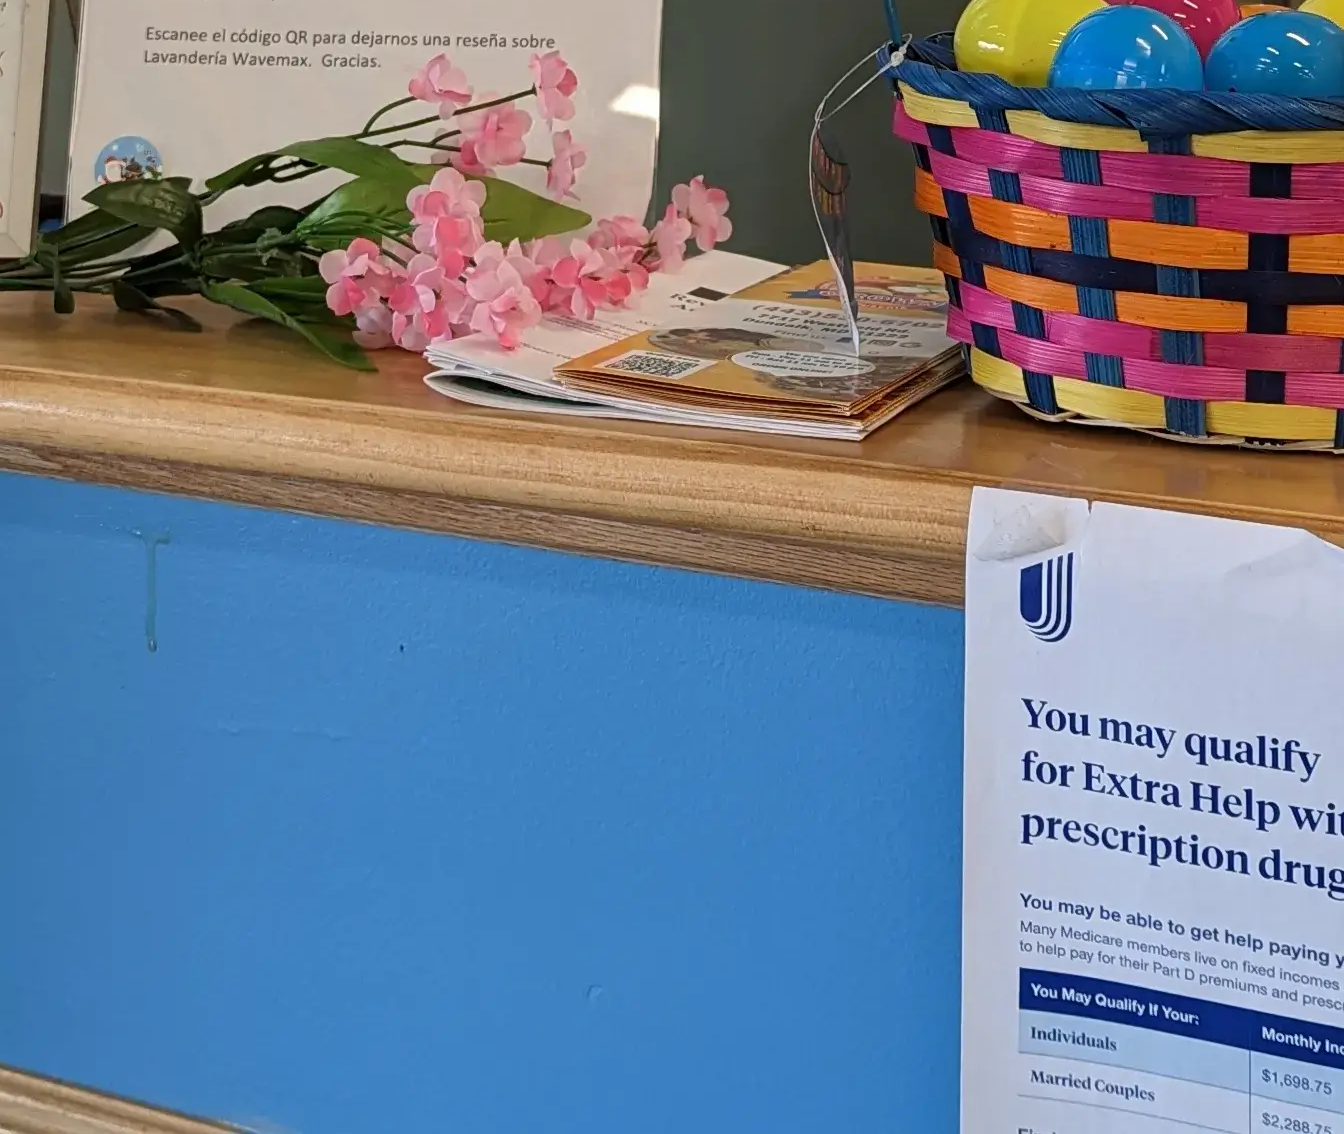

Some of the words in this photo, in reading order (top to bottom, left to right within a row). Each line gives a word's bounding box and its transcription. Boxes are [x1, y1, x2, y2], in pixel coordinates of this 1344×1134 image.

[144, 49, 228, 66] Lavandería
[232, 52, 313, 68] Wavemax.
[321, 53, 382, 69] Gracias.
[145, 26, 208, 42] Escanee
[212, 28, 227, 43] el
[230, 29, 282, 47] código
[285, 30, 309, 47] QR
[312, 33, 347, 48] para
[350, 31, 418, 48] dejarnos
[422, 35, 452, 48] una
[456, 33, 508, 49] reseña
[511, 34, 556, 50] sobre
[1020, 697, 1091, 738] You
[1098, 715, 1177, 758] may
[1184, 731, 1322, 783] qualify
[1021, 750, 1075, 788] for
[1082, 761, 1181, 808] Extra
[1189, 781, 1281, 832] Help
[1021, 812, 1250, 877] prescription
[1019, 893, 1053, 913] You
[1058, 900, 1095, 921] may
[1099, 904, 1122, 923] be
[1125, 911, 1164, 932] able
[1167, 918, 1186, 936] to
[1189, 923, 1221, 943] get
[1224, 929, 1265, 951] help
[1268, 938, 1331, 968] paying
[1019, 920, 1058, 940] Many
[1060, 926, 1124, 949] Medicare
[1127, 939, 1192, 963] members
[1194, 950, 1218, 968] live
[1220, 956, 1239, 970] on
[1242, 958, 1276, 978] fixed
[1279, 967, 1341, 992] incomes
[1030, 1025, 1118, 1052] Individuals
[1261, 1068, 1333, 1096] $1,698.75
[1261, 1025, 1323, 1052] Monthly
[1030, 1069, 1092, 1092] Married
[1094, 1079, 1156, 1103] Couples
[1261, 1112, 1333, 1134] $2,288.75
